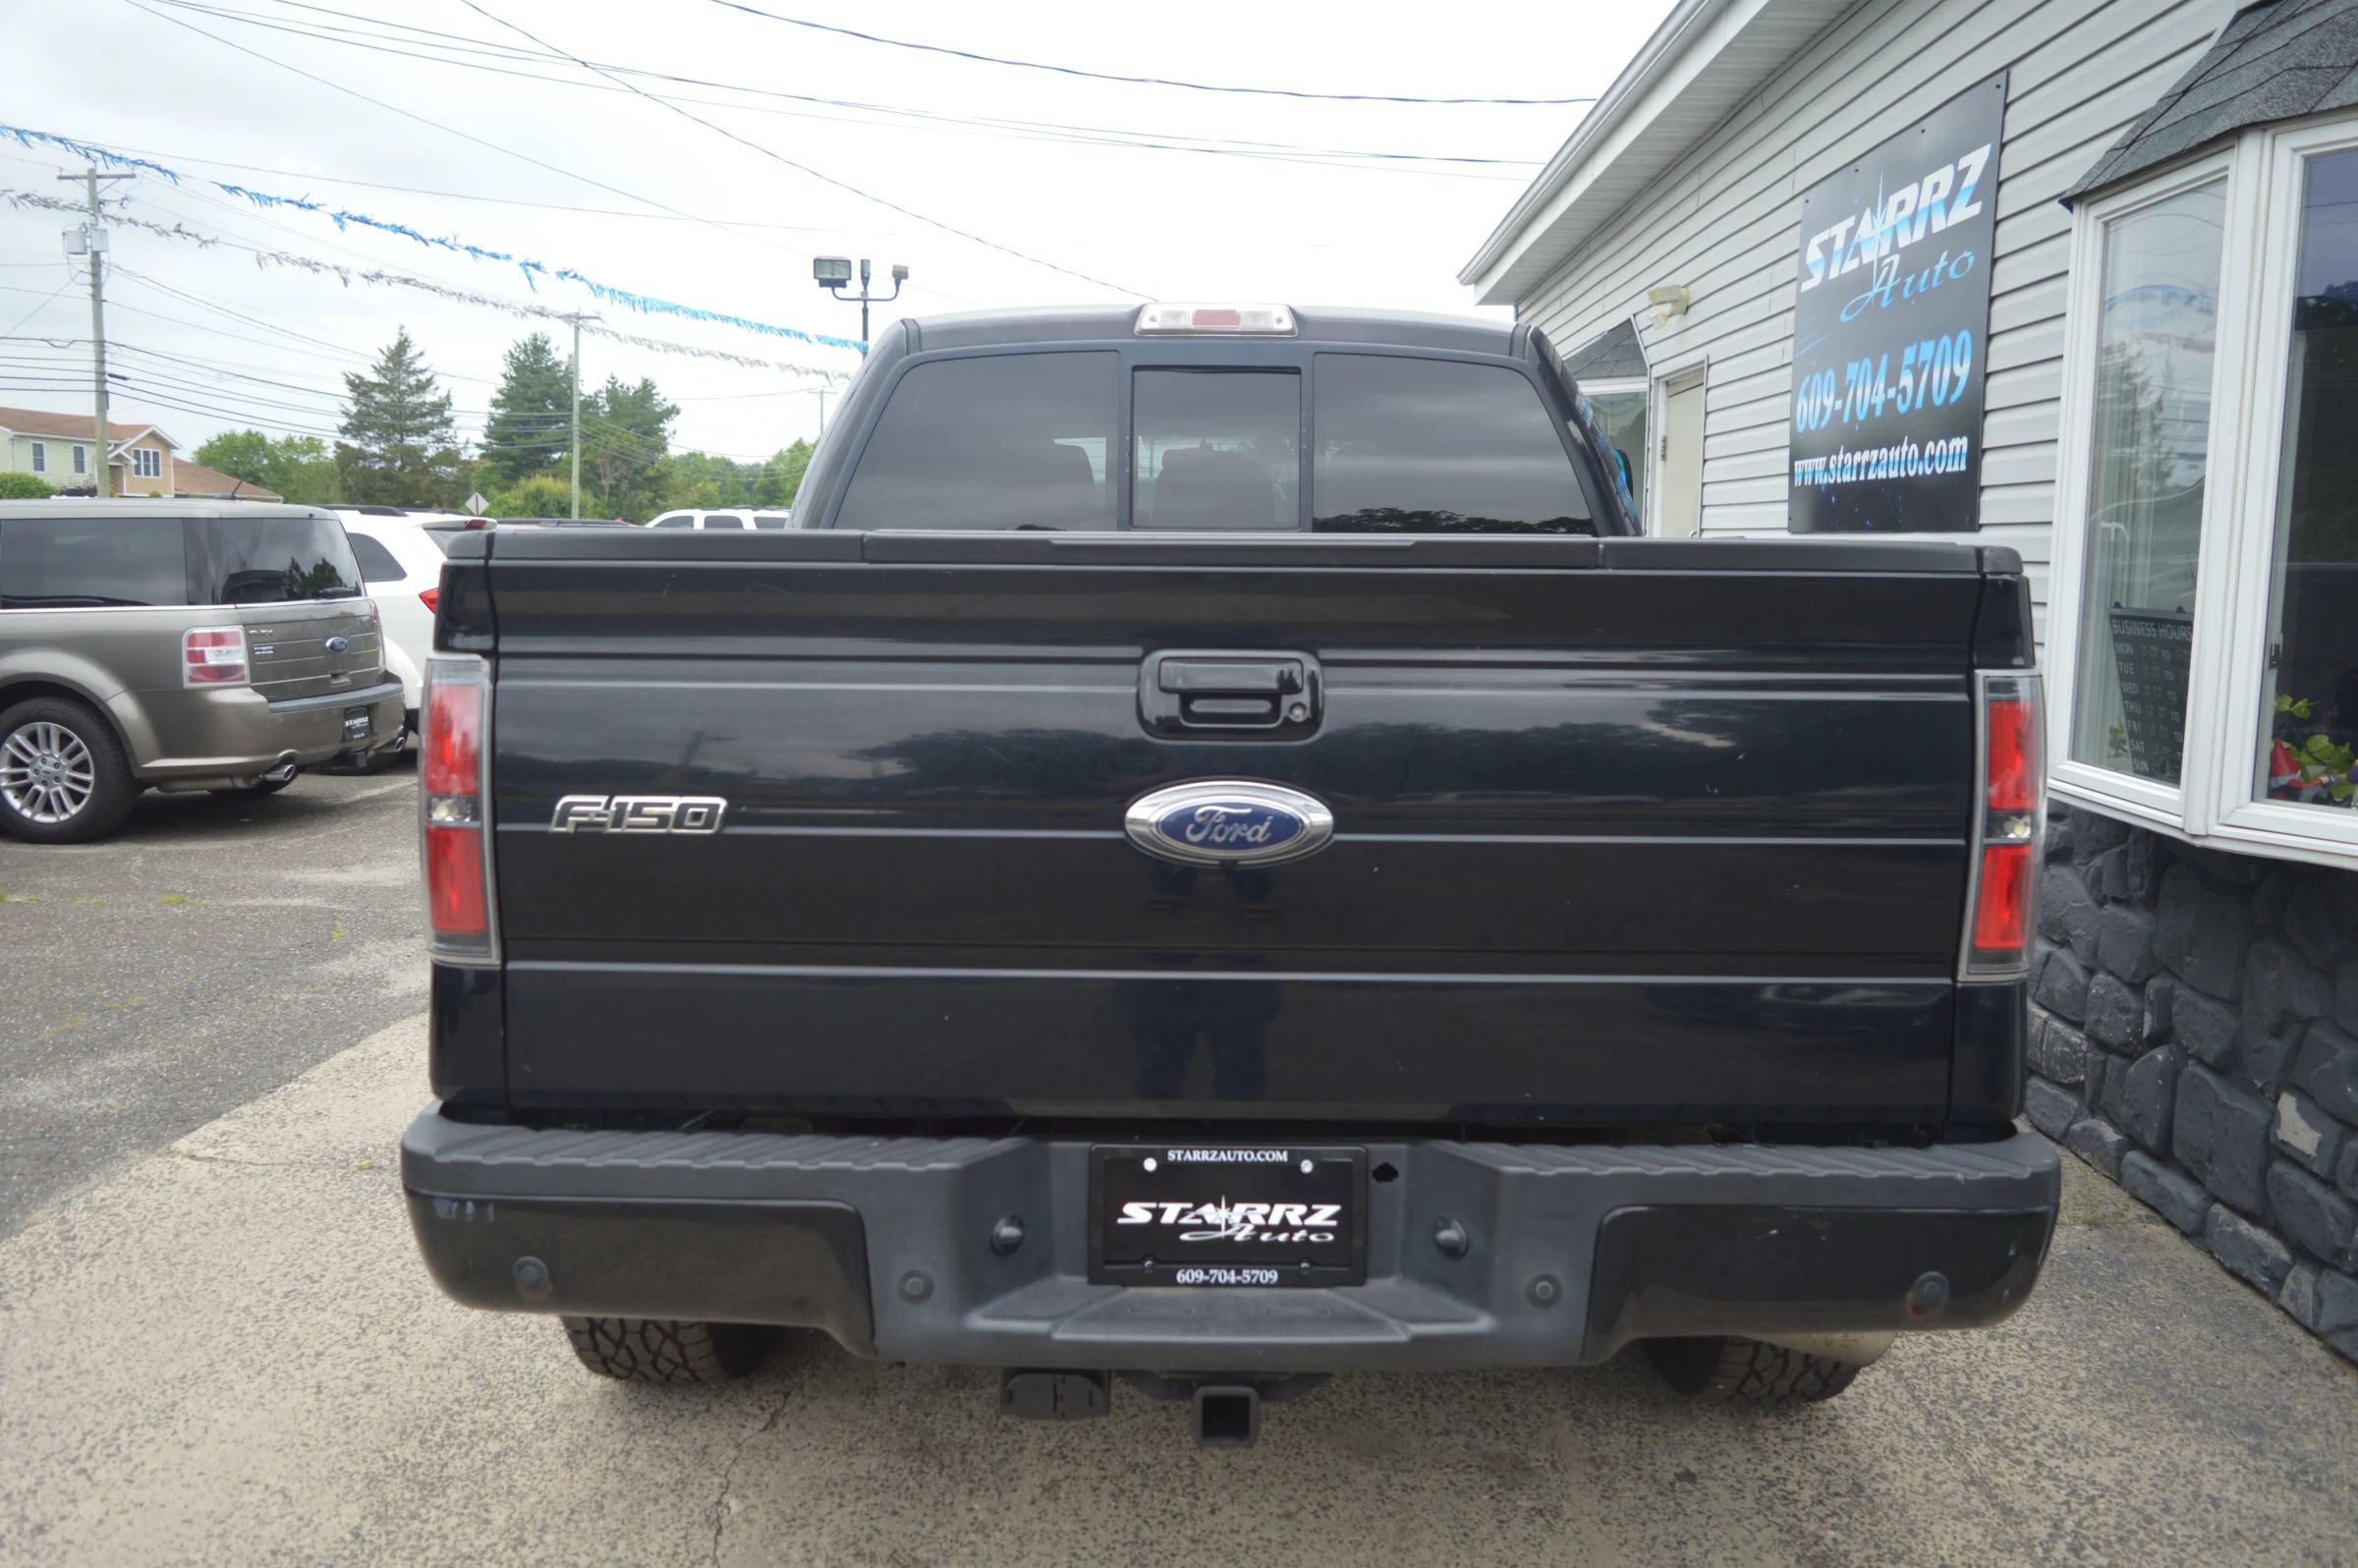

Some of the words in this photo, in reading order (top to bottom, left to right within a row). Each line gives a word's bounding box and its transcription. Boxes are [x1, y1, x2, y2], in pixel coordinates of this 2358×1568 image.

[1800, 142, 1992, 293] STARRZ
[1839, 250, 1975, 322] Auto
[1796, 329, 1972, 433] 609-704-5709
[1794, 435, 1968, 487] www.starrzauto.com
[2110, 619, 2158, 639] BUSINESS
[2158, 623, 2193, 642] HOURS
[2114, 642, 2134, 655] MON
[2117, 661, 2135, 676] TUE
[2121, 682, 2139, 695] WED
[2124, 700, 2142, 714] THU
[2127, 720, 2142, 733] FRI
[2130, 739, 2145, 754] SAT
[548, 795, 728, 834] F-150
[1185, 805, 1274, 843] Ford
[1167, 1149, 1289, 1163] STARRZAUTO.COM
[1116, 1201, 1342, 1226] STARRZ
[1179, 1223, 1334, 1243] Auto
[1176, 1268, 1279, 1285] 609-704-5709
